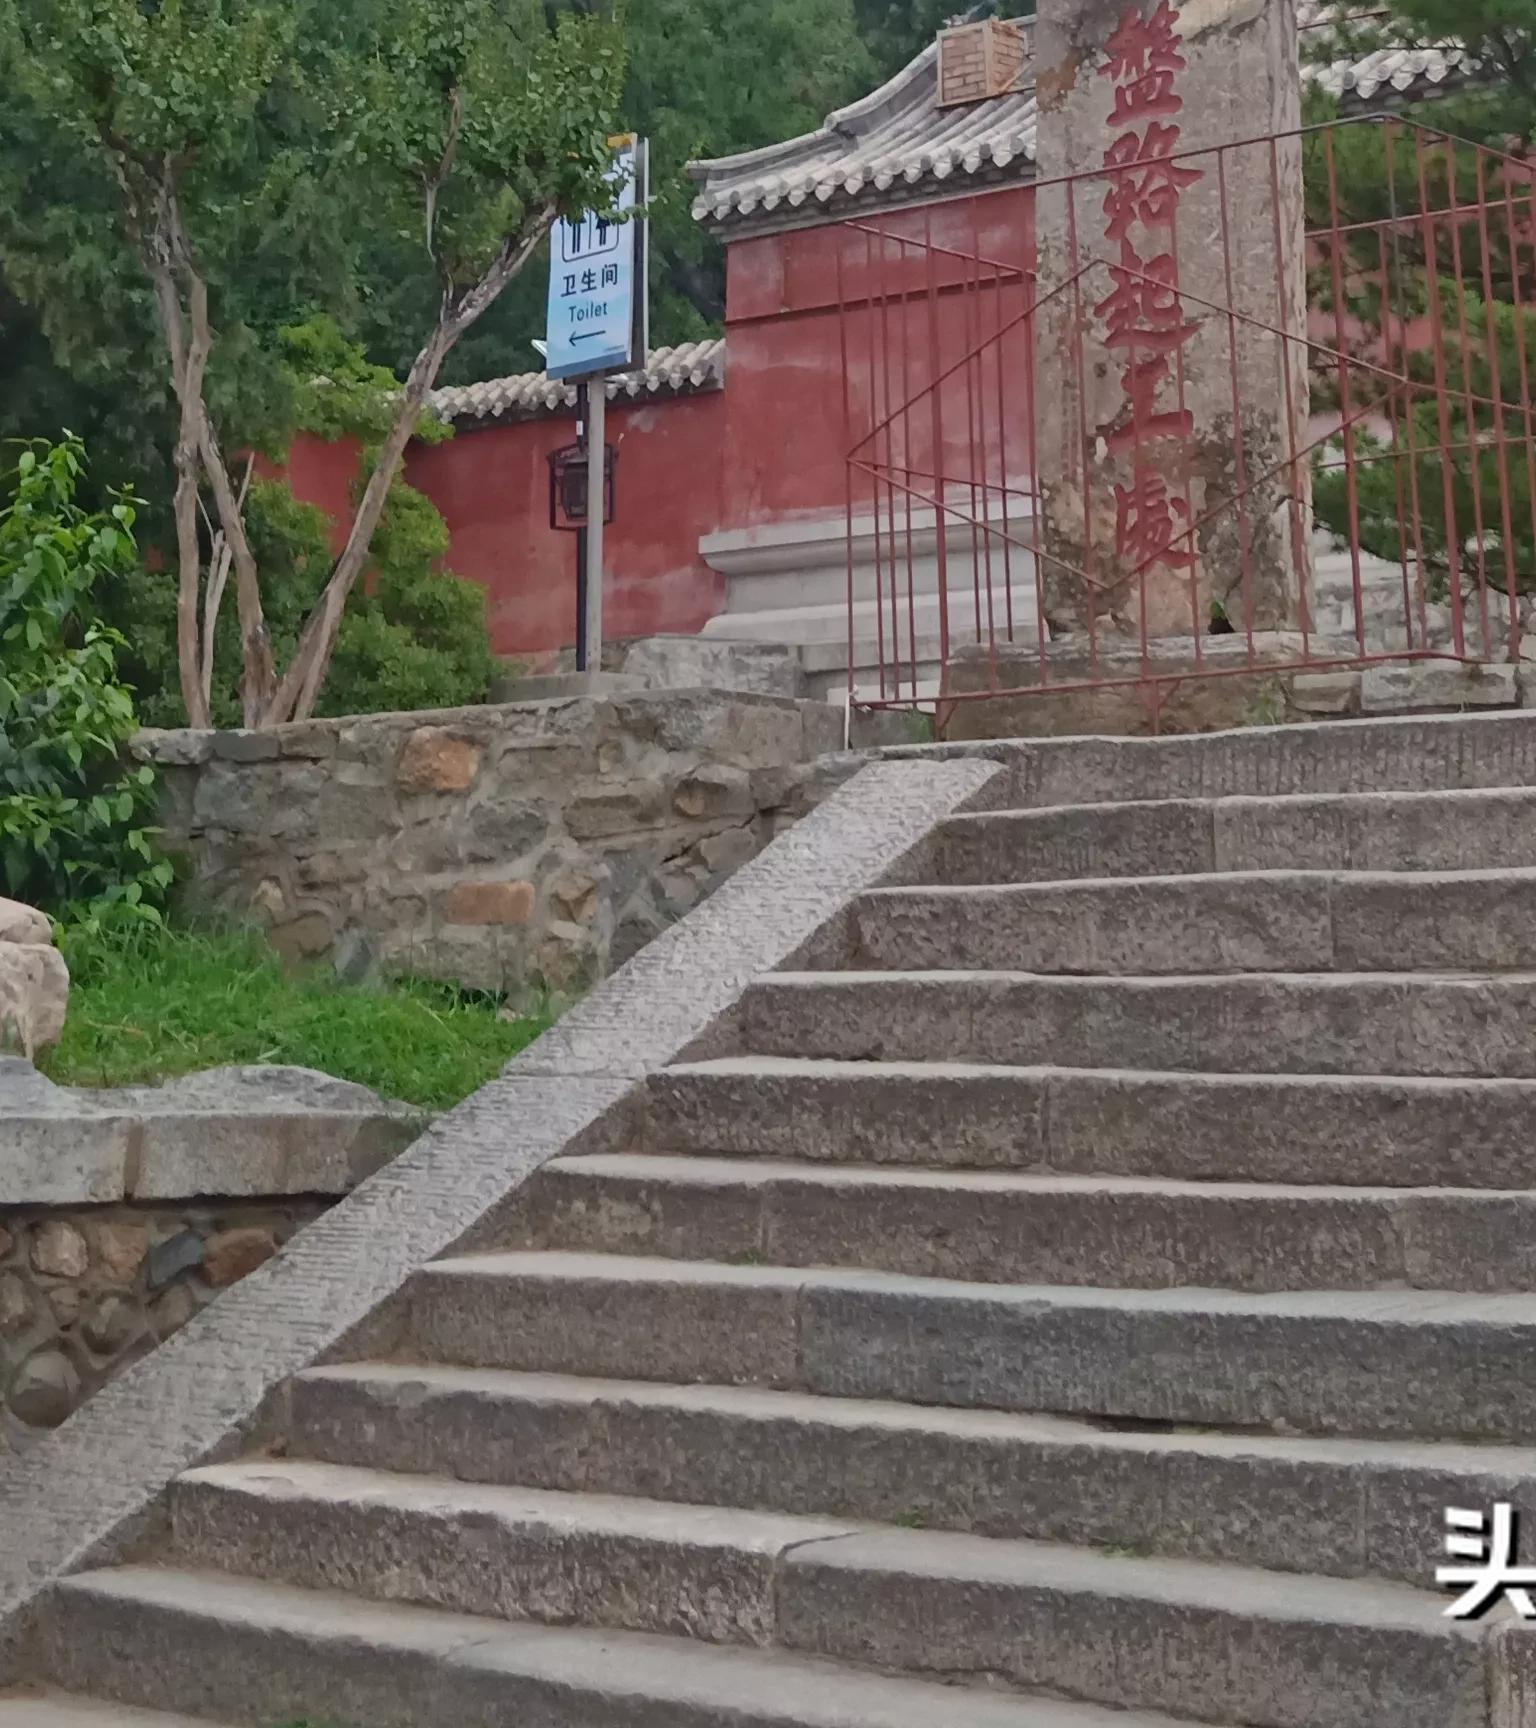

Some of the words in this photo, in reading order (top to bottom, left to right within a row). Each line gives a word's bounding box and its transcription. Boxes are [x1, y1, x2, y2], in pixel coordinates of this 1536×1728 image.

[560, 263, 618, 297] 卫生间
[568, 301, 608, 323] Toilet
